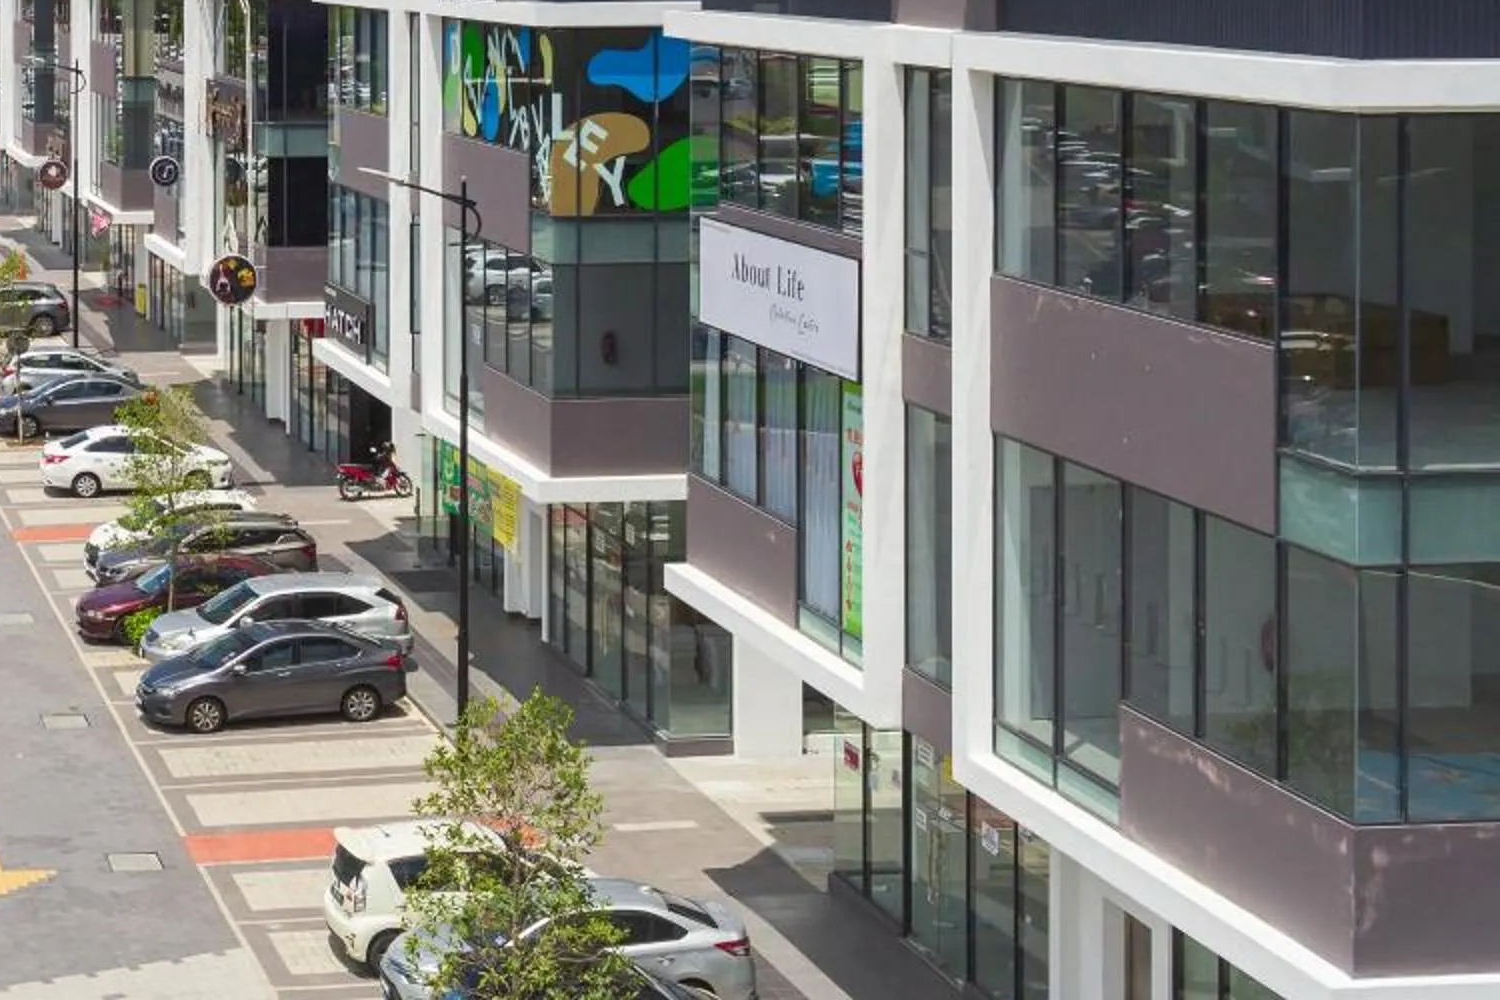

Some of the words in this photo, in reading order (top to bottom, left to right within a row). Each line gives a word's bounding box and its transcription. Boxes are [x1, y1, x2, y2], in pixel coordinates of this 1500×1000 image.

[731, 252, 772, 289] About
[777, 266, 805, 301] Life
[324, 303, 361, 345] HATCH
